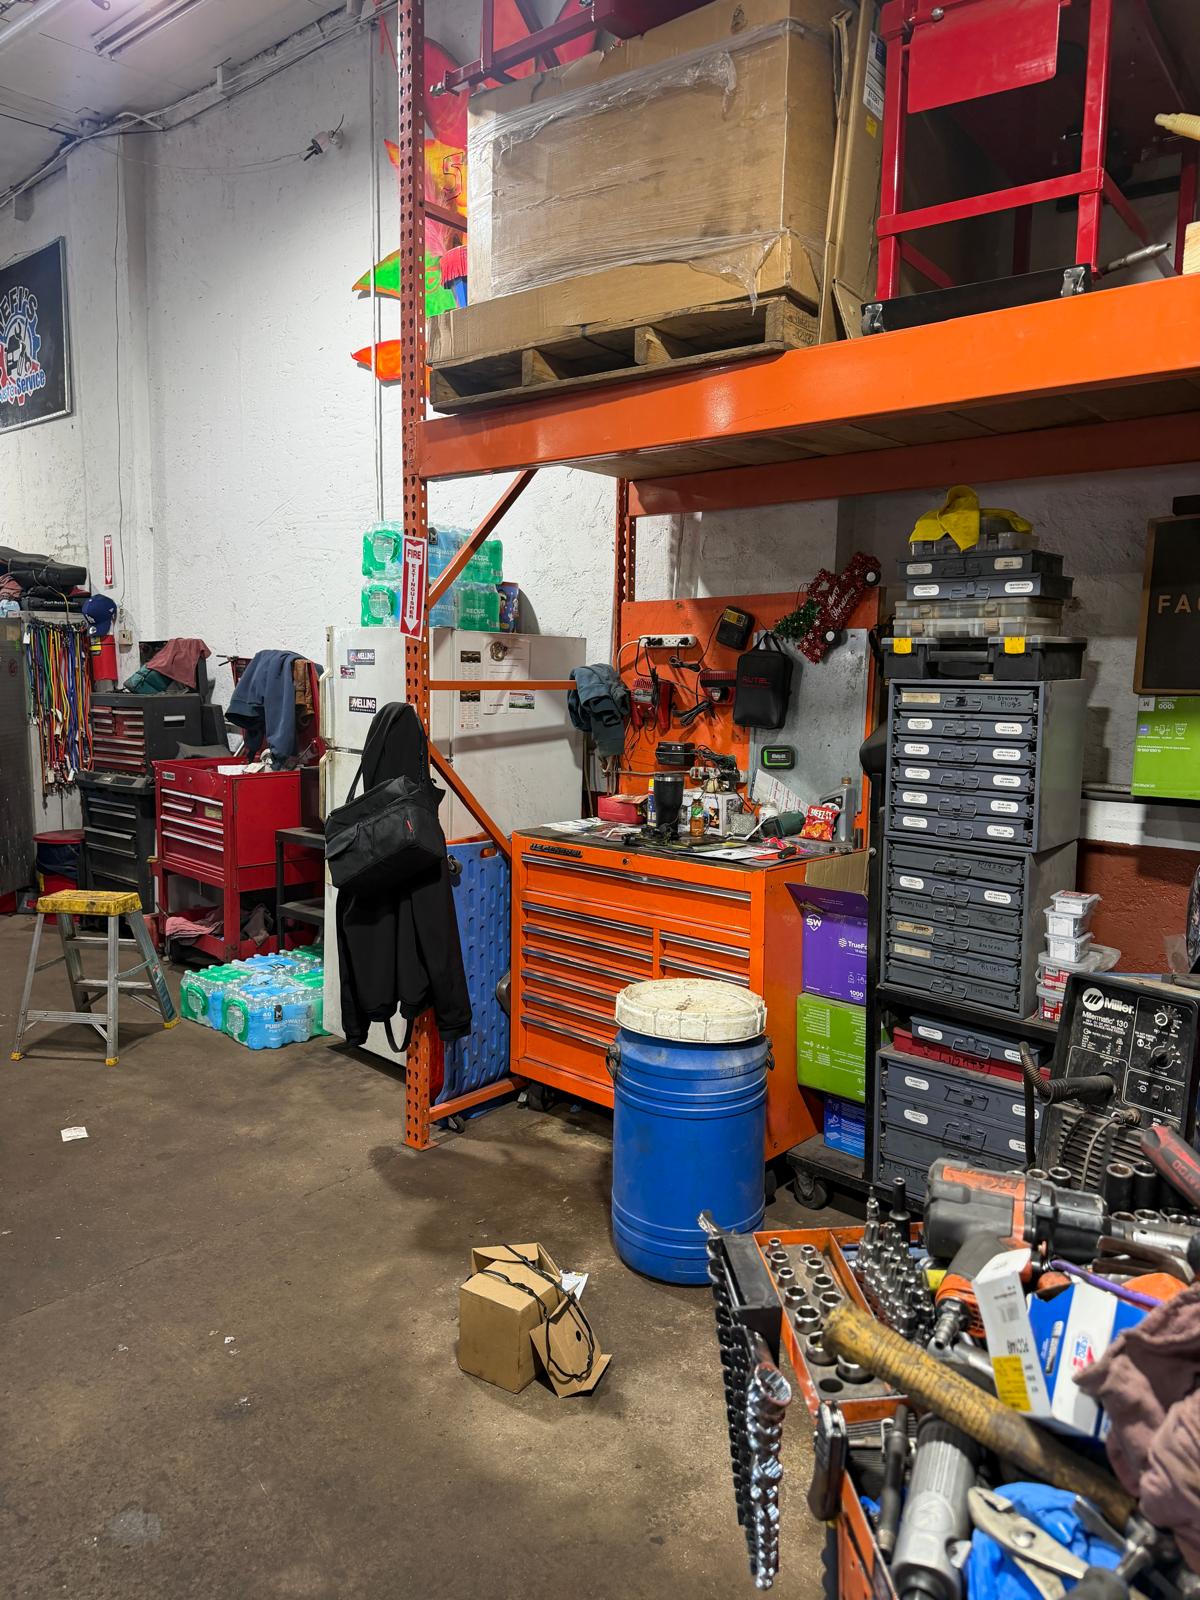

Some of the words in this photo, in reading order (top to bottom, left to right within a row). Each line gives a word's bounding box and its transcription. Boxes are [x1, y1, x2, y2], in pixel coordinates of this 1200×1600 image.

[16, 369, 46, 393] Service
[407, 548, 422, 560] FIRE
[351, 698, 376, 709] MELLING
[806, 917, 822, 928] SW
[850, 990, 864, 998] 1000
[1116, 1019, 1129, 1029] 130
